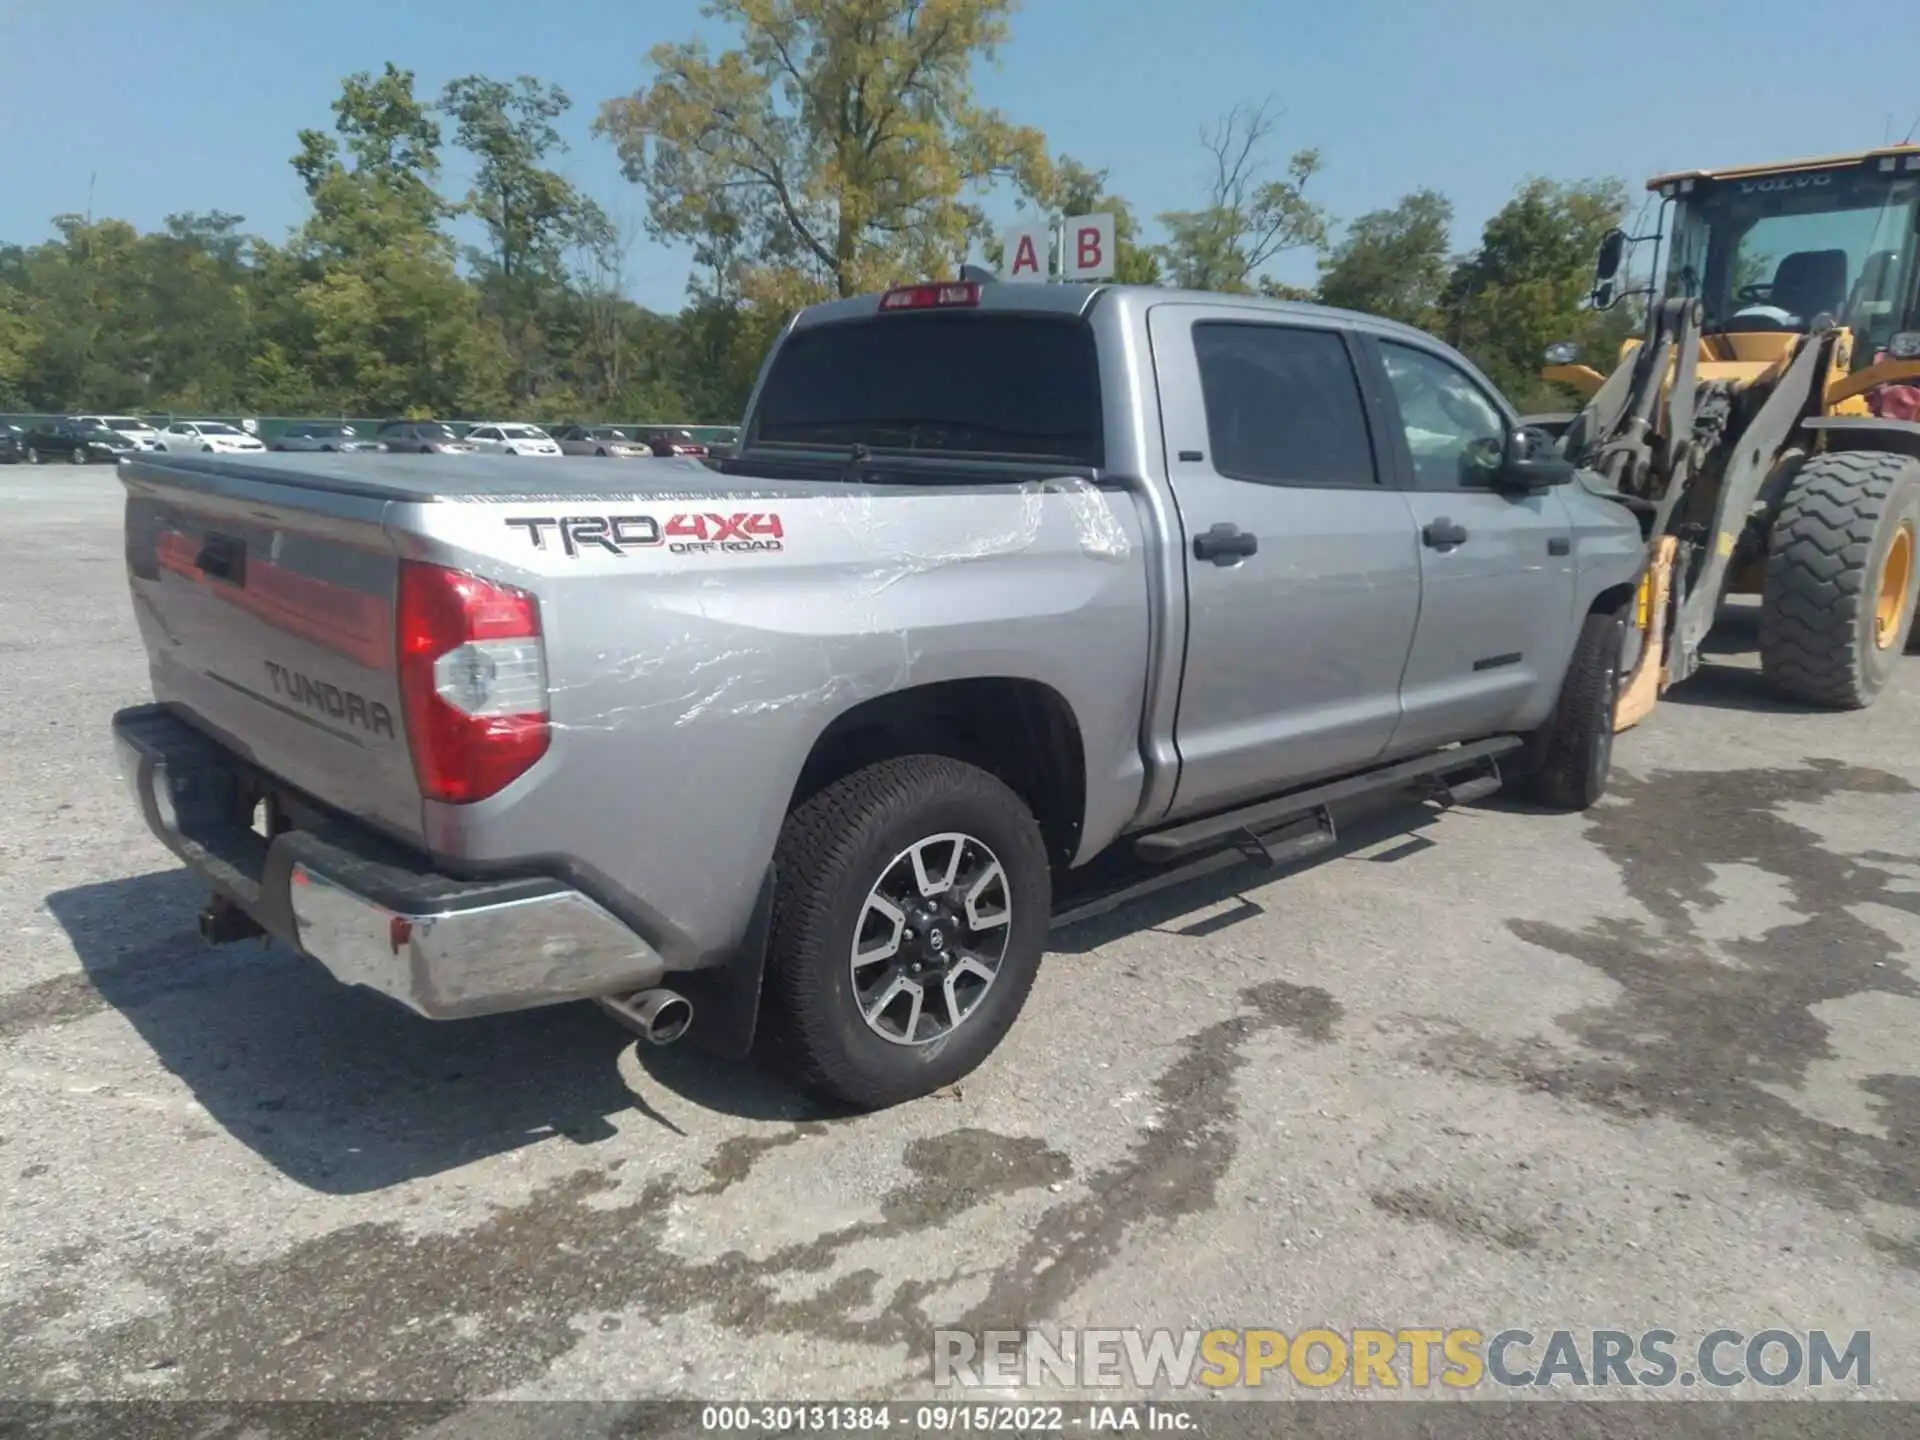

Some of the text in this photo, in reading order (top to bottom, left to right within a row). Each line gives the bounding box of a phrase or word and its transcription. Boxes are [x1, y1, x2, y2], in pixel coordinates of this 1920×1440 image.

[1012, 233, 1039, 275] A
[1077, 227, 1102, 270] B
[504, 514, 663, 558] TRD
[669, 540, 782, 554] OFF ROAD
[264, 660, 396, 741] TUNDRA
